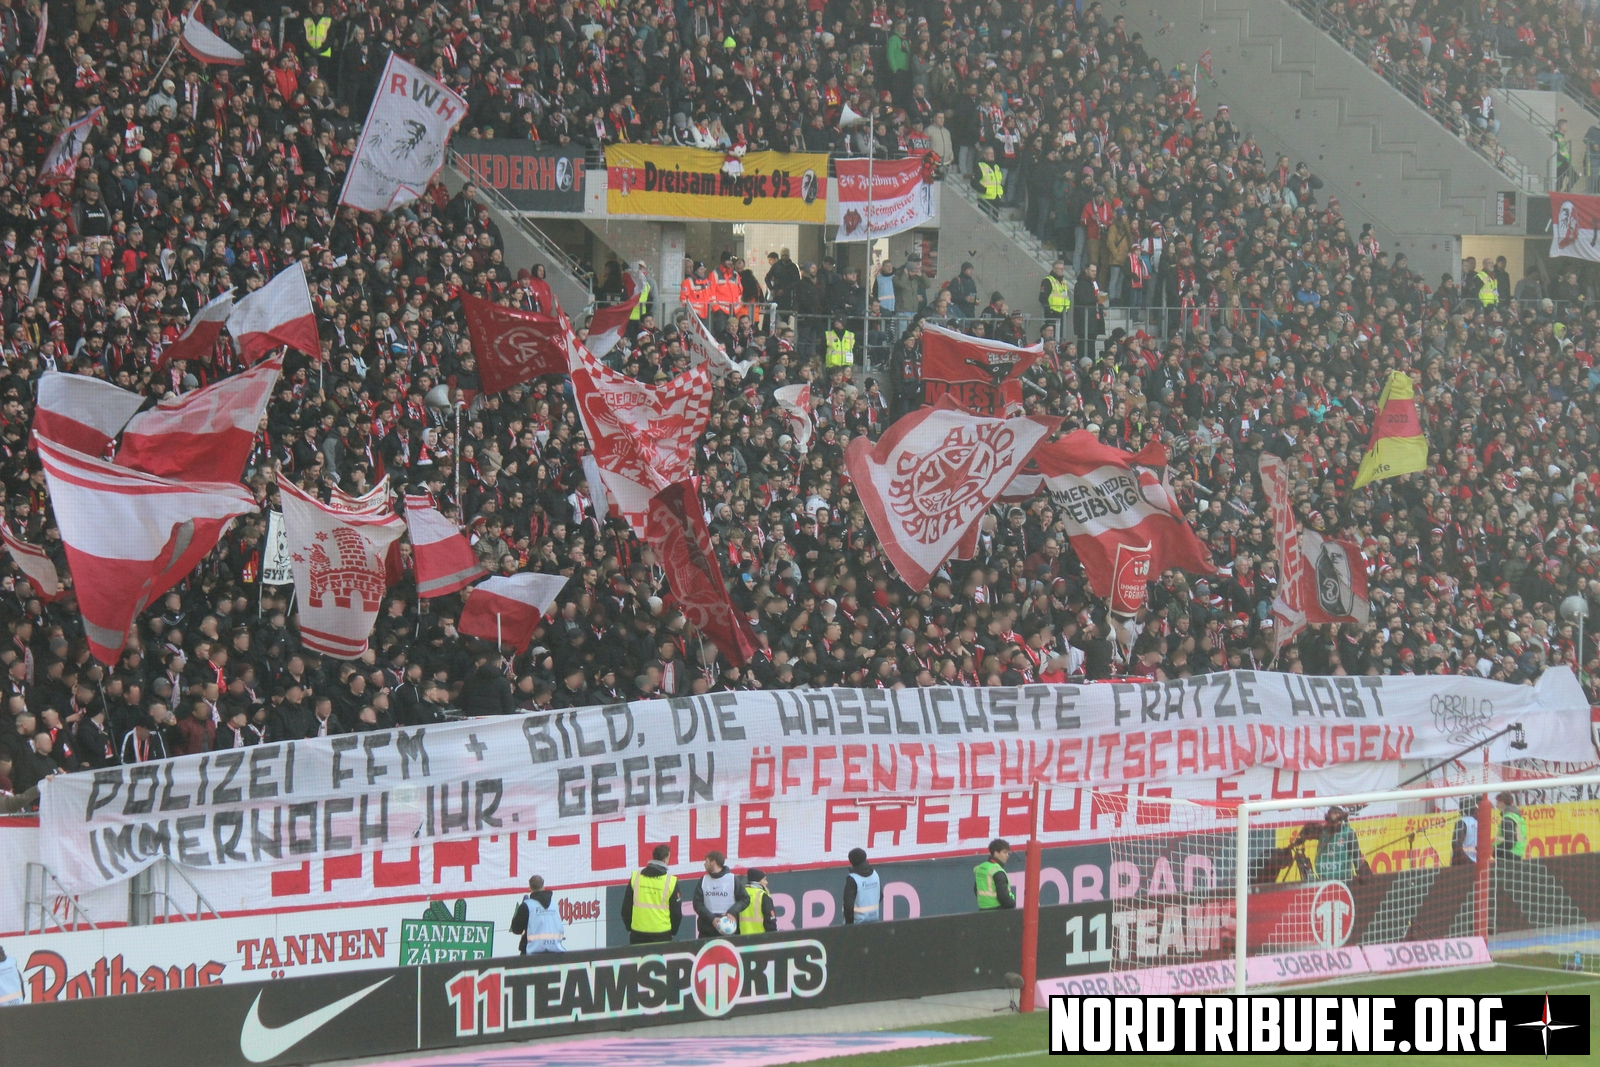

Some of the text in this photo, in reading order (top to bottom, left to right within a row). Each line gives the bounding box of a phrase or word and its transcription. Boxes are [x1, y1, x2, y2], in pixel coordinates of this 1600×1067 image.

[390, 73, 457, 121] RWH
[644, 161, 716, 196] Dreisam
[771, 169, 791, 198] 95
[1387, 414, 1410, 424] 2022
[1091, 475, 1135, 497] WIEDER
[86, 741, 296, 822] POLIZEI
[331, 728, 431, 789] FFM
[522, 702, 645, 764] BILD,
[666, 692, 746, 746] DIE
[771, 687, 1082, 736] HÄSSLICHSTE
[1111, 670, 1262, 726] FRATZE
[1283, 674, 1384, 718] HABT
[90, 791, 390, 880] IMMERNOCH
[557, 751, 715, 818] GEGEN
[1528, 807, 1556, 820] LOTTO
[1371, 832, 1591, 875] OTTO OTTO
[705, 890, 728, 898] JOBRAD
[237, 927, 389, 971] TANNEN
[405, 923, 491, 945] TANNEN
[24, 949, 228, 1004] Rothaus
[1272, 950, 1353, 977] JOBRAD
[1383, 939, 1474, 967] JOBRAD
